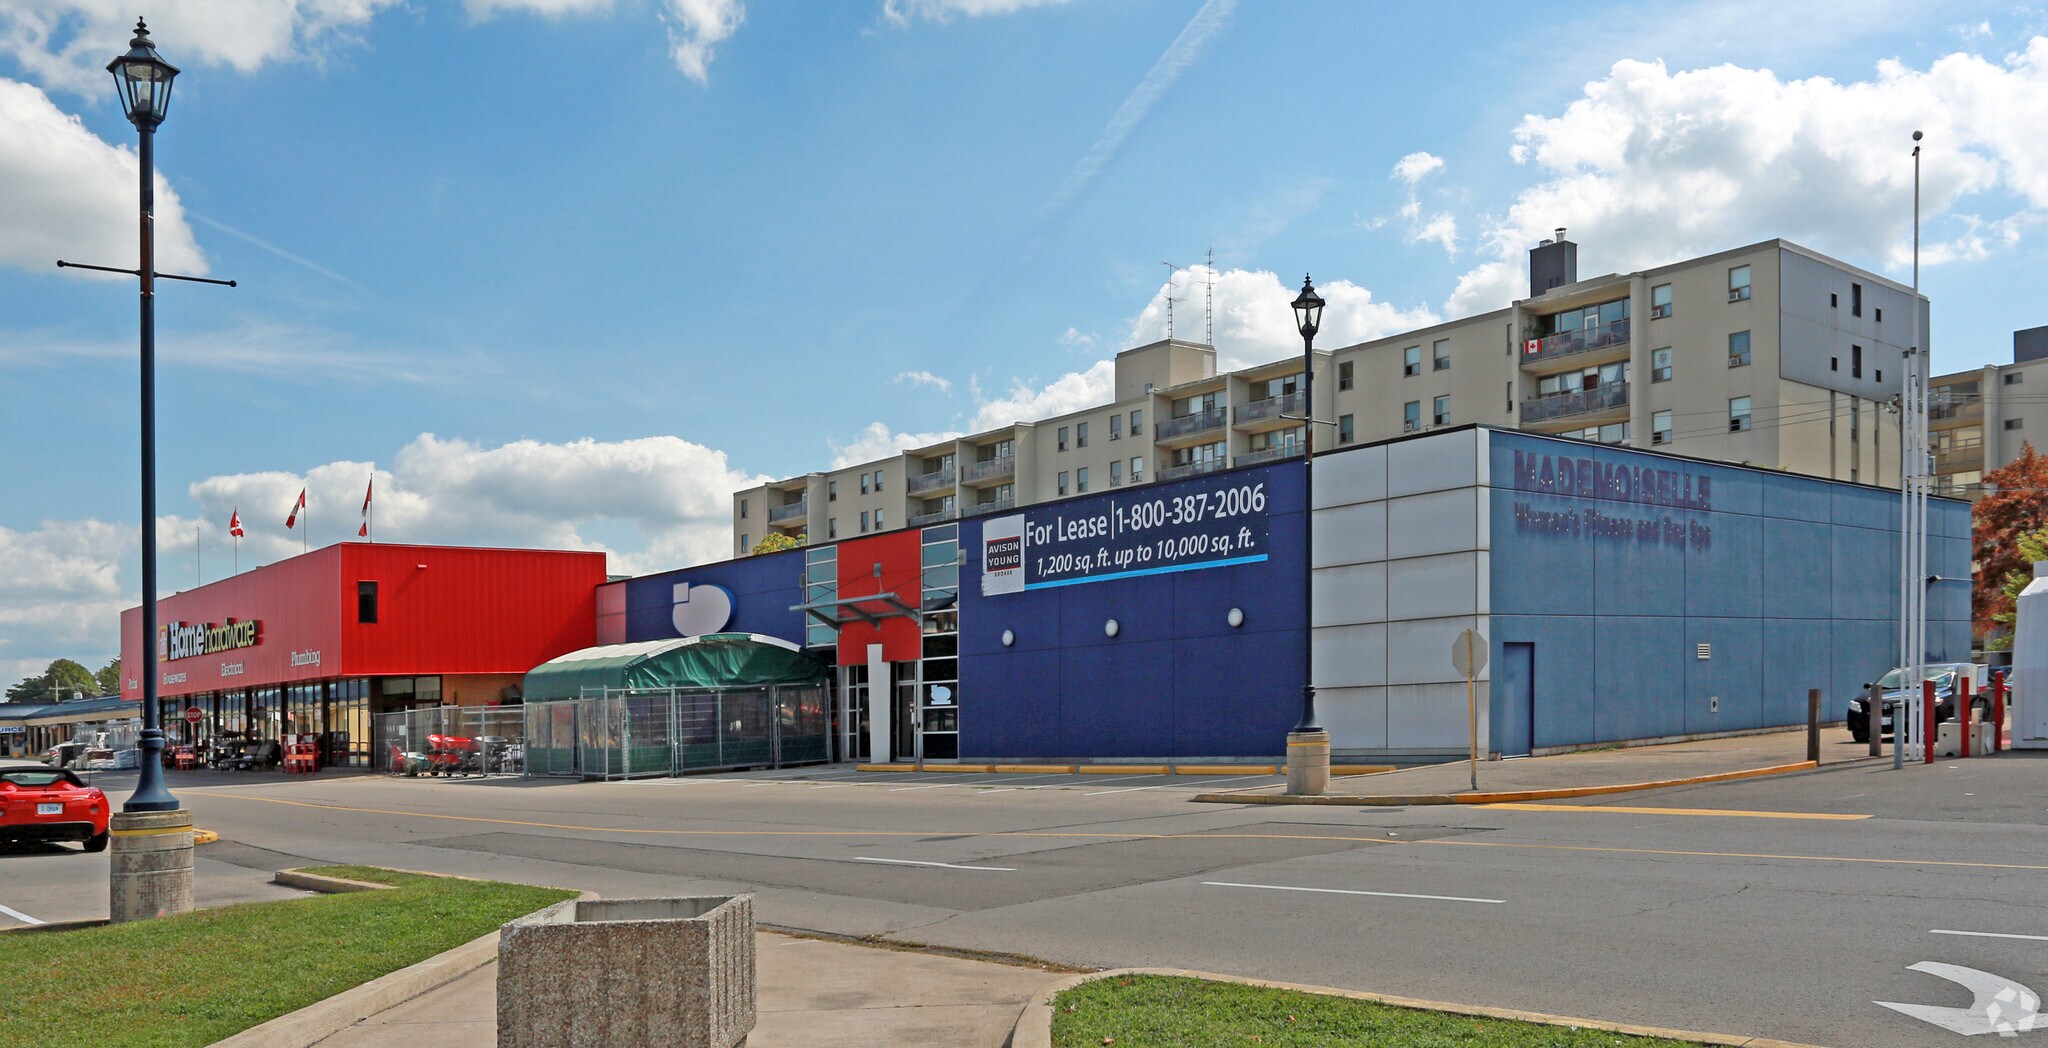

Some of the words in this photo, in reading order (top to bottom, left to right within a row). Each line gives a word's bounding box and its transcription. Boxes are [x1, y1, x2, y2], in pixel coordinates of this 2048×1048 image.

[1513, 450, 1712, 511] MADEMOISELLE
[1026, 521, 1053, 547] For
[1058, 512, 1107, 542] Lease
[1116, 483, 1265, 533] 1-800-387-2006
[1636, 513, 1660, 540] and
[988, 541, 1019, 554] AVISON
[1037, 553, 1073, 578] 1,200
[1074, 556, 1094, 575] sq.
[1097, 548, 1112, 567] ft.
[1115, 547, 1134, 569] up
[1136, 543, 1152, 562] to
[1157, 532, 1208, 559] 10,000
[1211, 537, 1234, 556] sq.
[1237, 526, 1255, 548] ft.
[988, 555, 1019, 567] YOUNG
[169, 621, 204, 660] Home
[221, 660, 244, 677] Electrical
[290, 649, 321, 667] Plumbing
[186, 711, 201, 719] STOP
